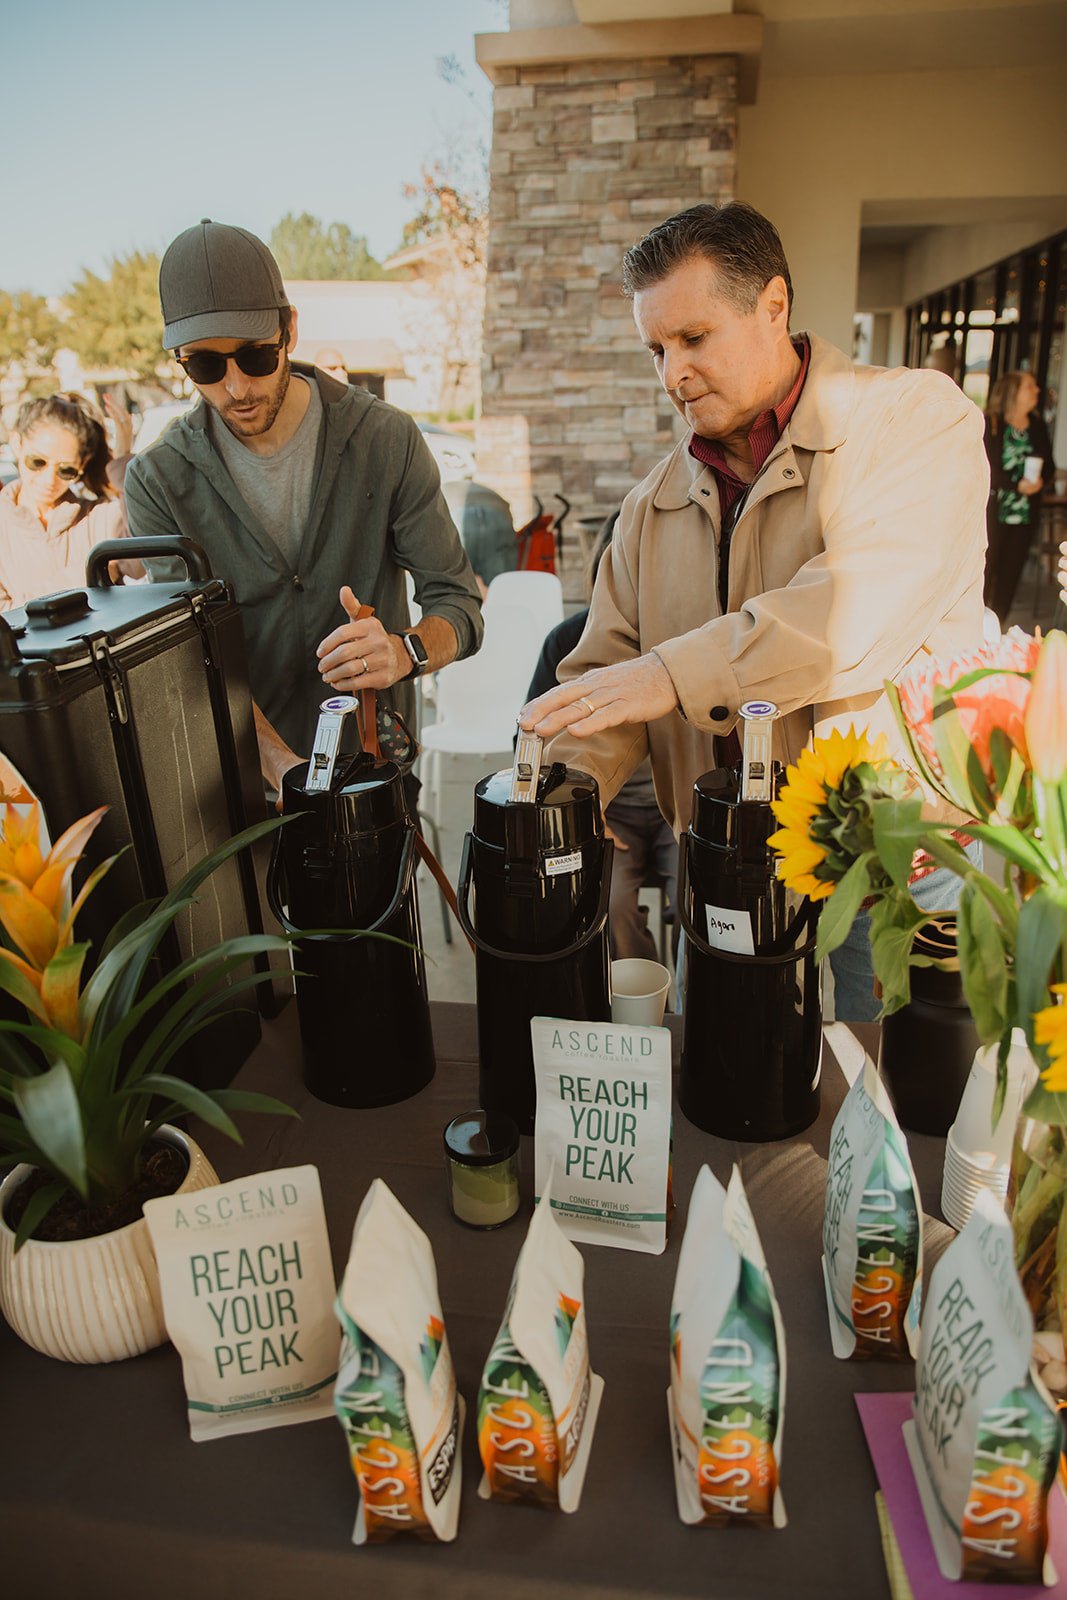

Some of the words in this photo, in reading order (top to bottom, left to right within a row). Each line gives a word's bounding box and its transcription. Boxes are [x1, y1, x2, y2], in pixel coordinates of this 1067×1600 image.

[552, 1030, 653, 1056] ASCEND
[565, 1050, 596, 1059] coffee
[559, 1074, 648, 1110] REACH
[569, 1105, 637, 1147] YOUR
[565, 1144, 635, 1185] PEAK
[175, 1184, 299, 1229] ASCEND
[569, 1195, 599, 1208] CONNECT
[601, 1200, 618, 1211] WITH
[619, 1203, 630, 1212] US
[190, 1240, 302, 1296] REACH
[851, 1188, 897, 1343] ASCEND
[208, 1289, 298, 1338] YOUR
[938, 1277, 996, 1397] REACH
[215, 1331, 304, 1379] PEAK
[928, 1324, 965, 1428] YOUR
[228, 1390, 268, 1403] CONNECT
[482, 1337, 538, 1484] ASCEN
[338, 1347, 412, 1521] ASCEND
[702, 1338, 753, 1514] ASCEND
[961, 1407, 1031, 1559] ASCEN
